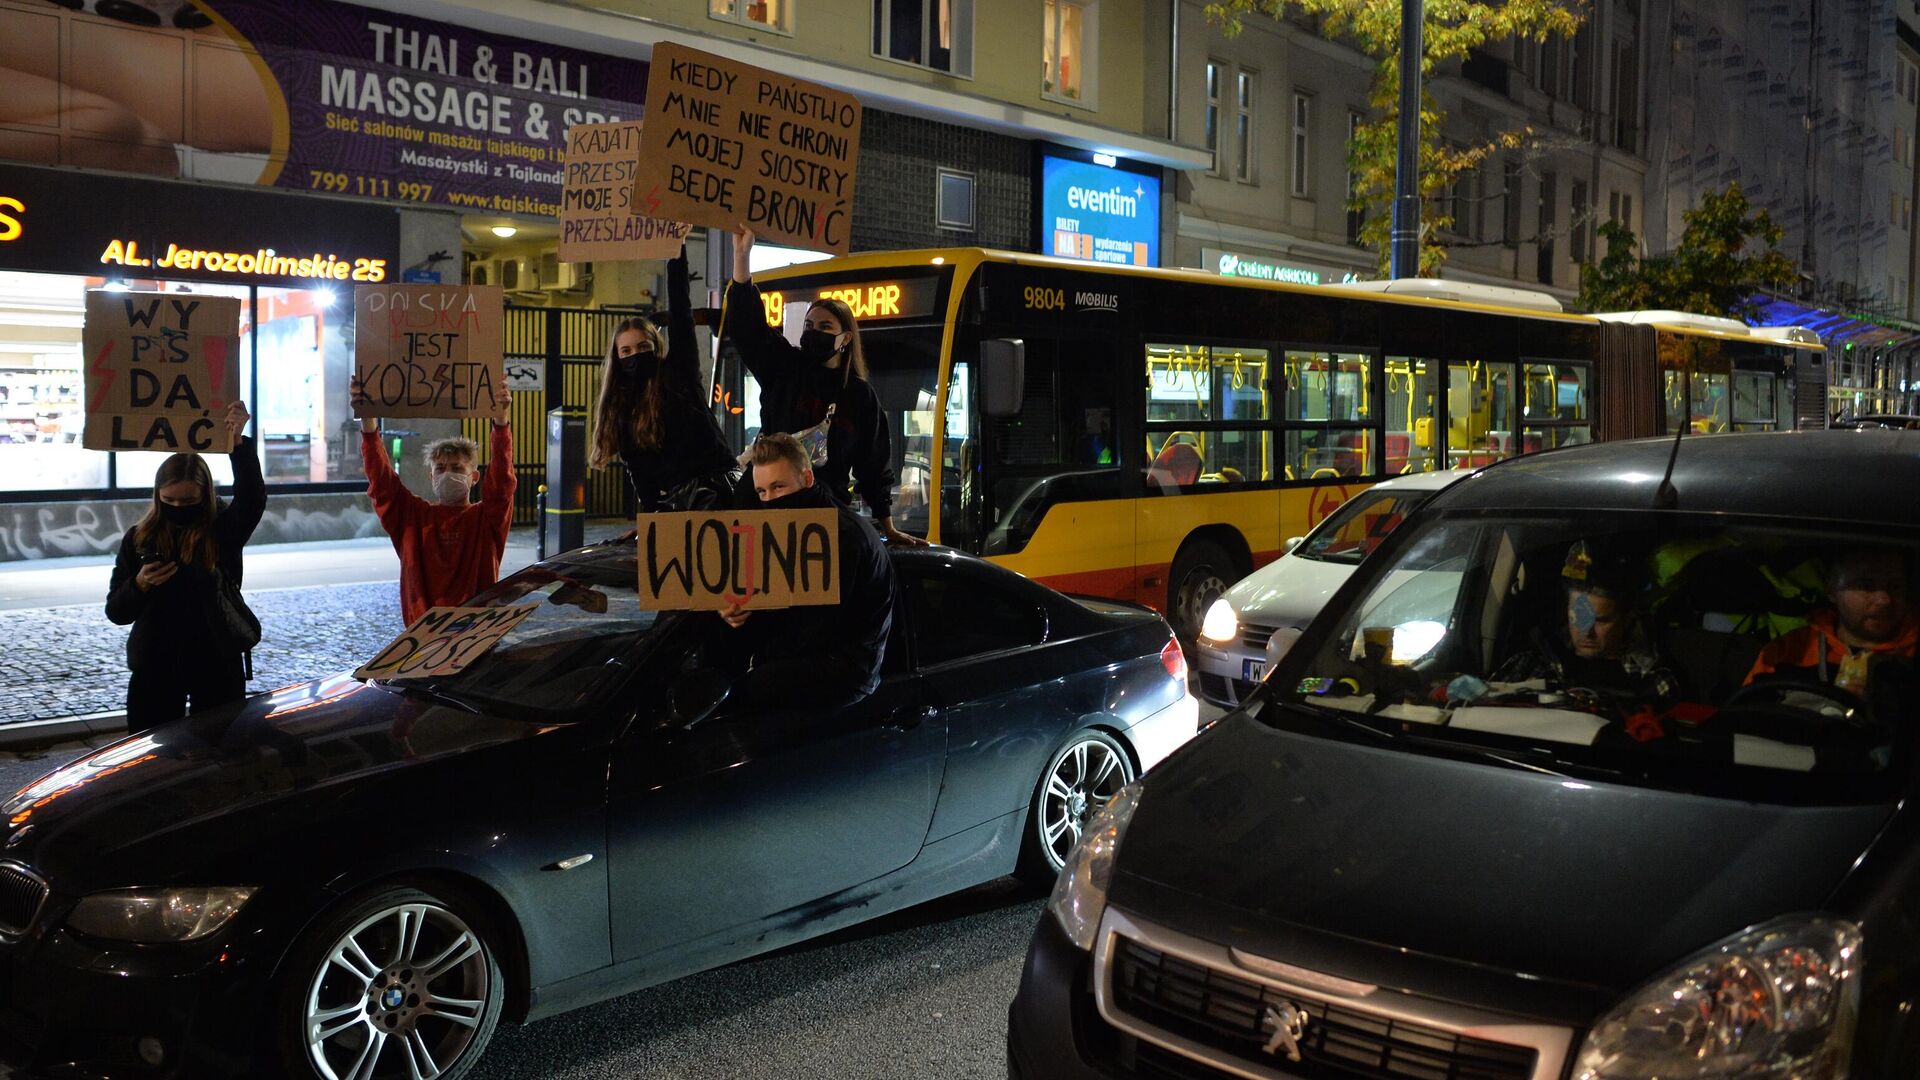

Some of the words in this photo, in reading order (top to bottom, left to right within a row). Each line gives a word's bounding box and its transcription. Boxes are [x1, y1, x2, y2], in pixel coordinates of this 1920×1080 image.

[368, 22, 457, 77] THAI
[473, 45, 498, 85] &
[513, 52, 588, 100] BALI
[321, 65, 512, 135] MASSAGE
[525, 103, 550, 140] &
[670, 58, 738, 95] KIEDY
[758, 82, 855, 128] PAŃSTWO
[326, 112, 359, 132] Sieć
[364, 121, 424, 141] salonów
[428, 131, 482, 151] masażu
[487, 140, 545, 162] tajskiego
[662, 91, 721, 127] MNIE
[738, 111, 771, 140] NIE
[779, 121, 848, 162] CHRONI
[400, 148, 487, 175] Masażystki
[494, 166, 502, 177] z
[507, 163, 564, 185] Tajlandi
[666, 128, 744, 170] MOJEJ
[759, 149, 848, 198] SIOSTRY
[310, 170, 348, 192] 799
[356, 176, 389, 197] 111
[398, 181, 433, 202] 997
[448, 192, 561, 218] www.tajskiesp
[565, 188, 612, 211] MOJE
[668, 164, 735, 213] BĘDĘ
[1067, 186, 1137, 218] eventim
[100, 239, 151, 267] AL.
[156, 243, 351, 280] Jerozolimskie
[352, 258, 387, 283] 25
[1024, 286, 1065, 311] 9804
[1075, 291, 1118, 308] MOBILIS
[402, 332, 459, 364] JEST
[129, 368, 201, 410] DA
[111, 410, 215, 450] LAĆ
